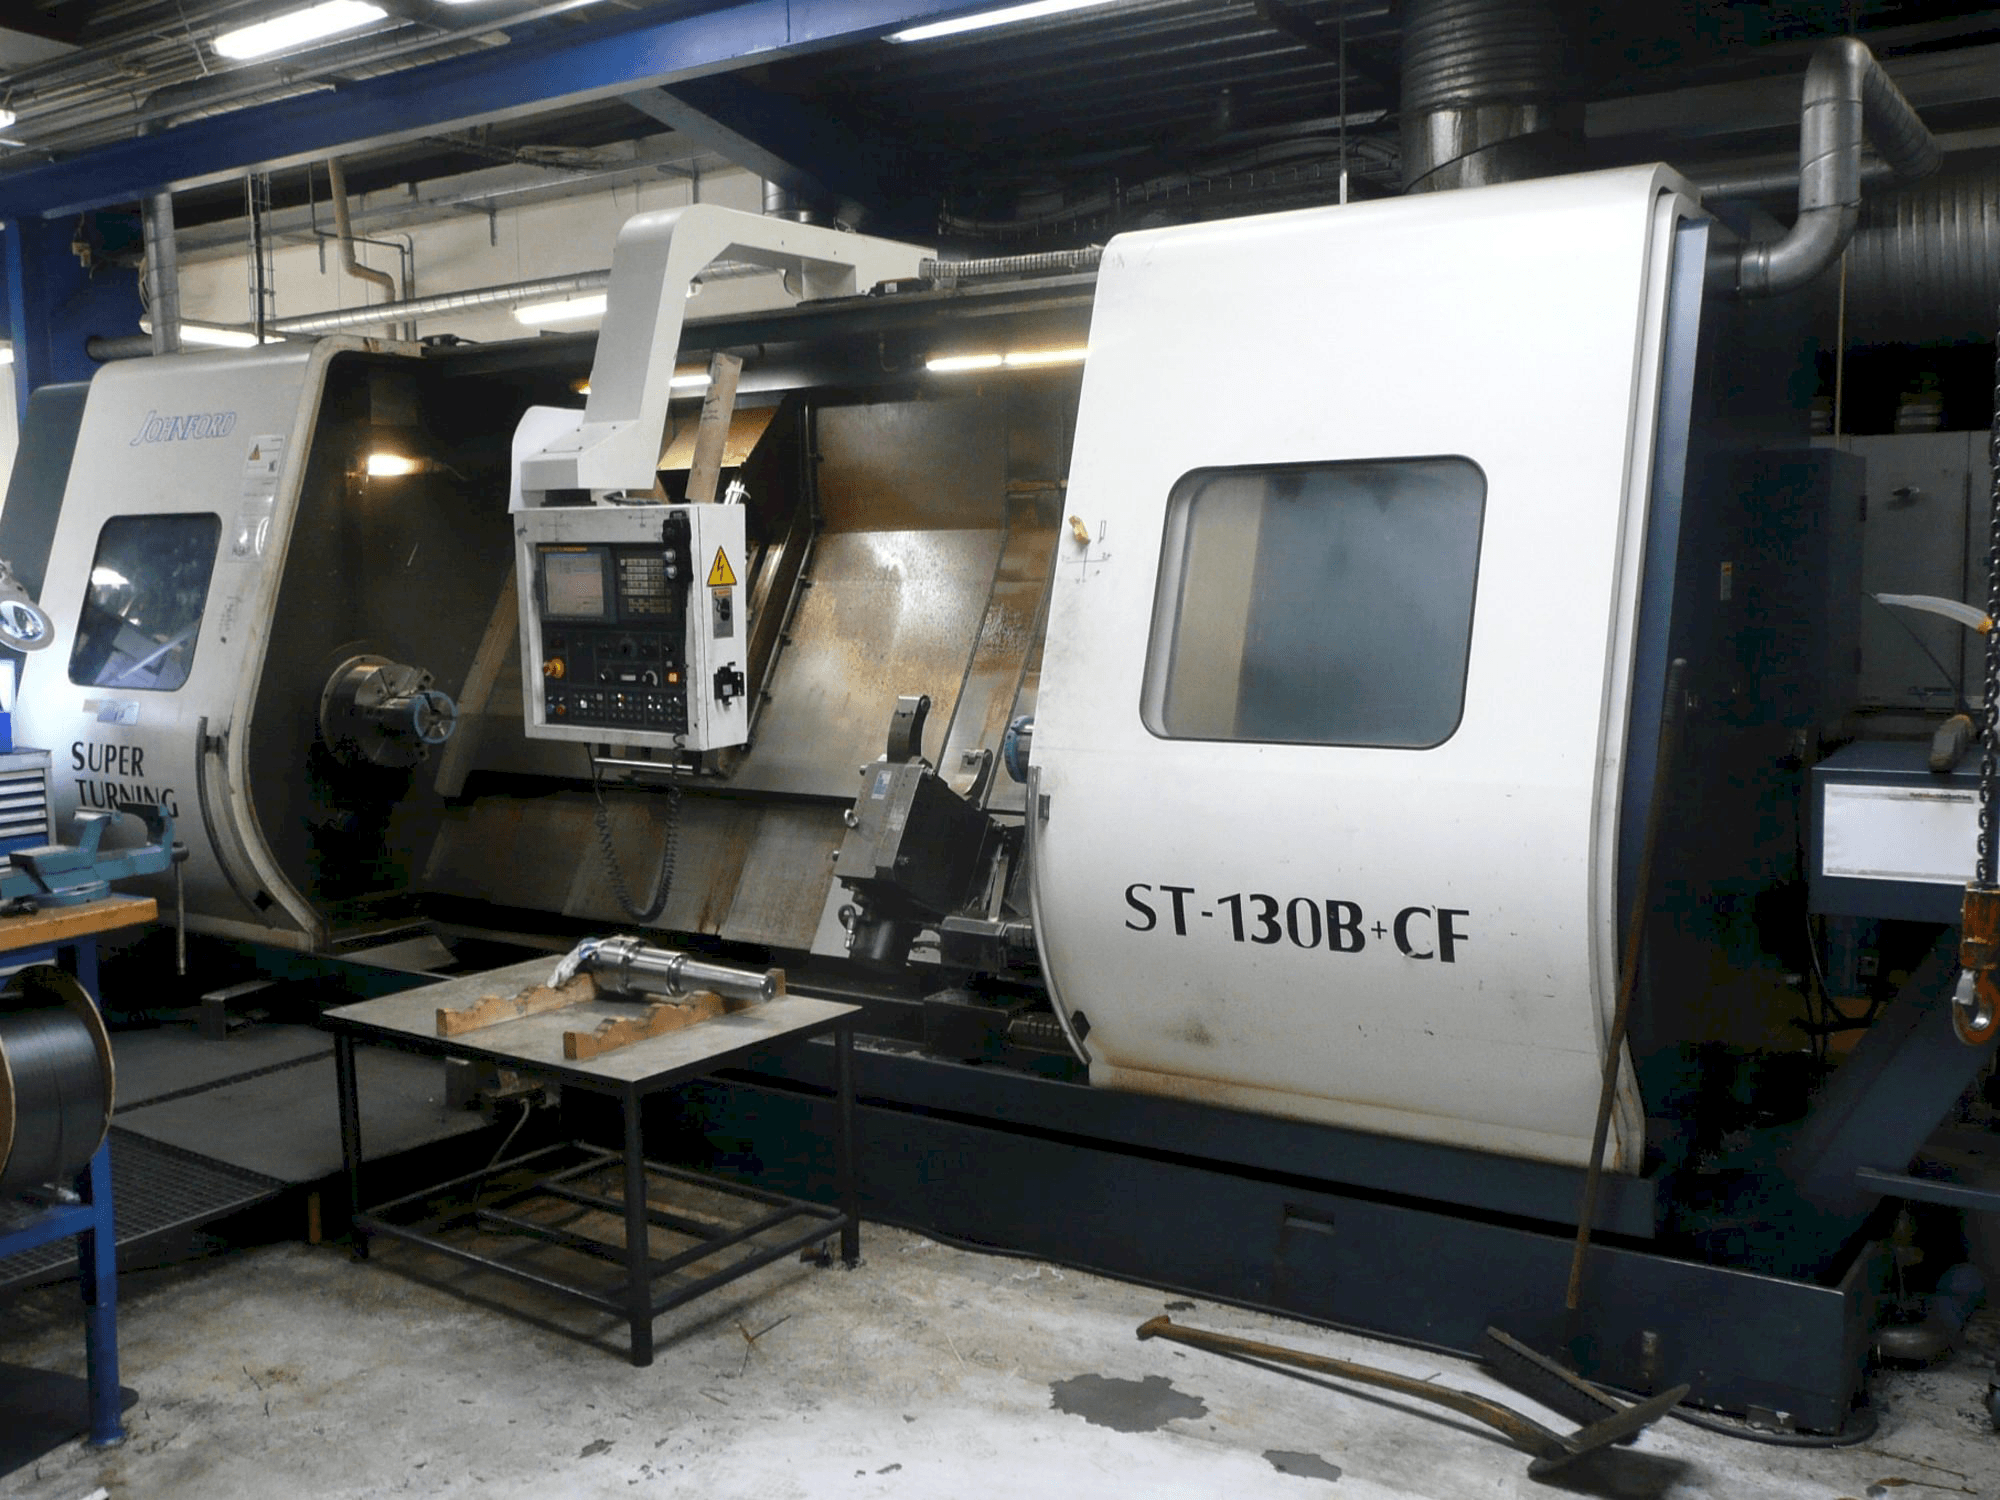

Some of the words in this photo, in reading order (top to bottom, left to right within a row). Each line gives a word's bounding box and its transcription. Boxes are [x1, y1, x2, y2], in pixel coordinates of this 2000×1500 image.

[129, 409, 237, 447] JOHNFORD
[71, 741, 145, 778] SUPER
[74, 779, 179, 818] TURNING
[1124, 882, 1471, 963] ST-130B+CF
